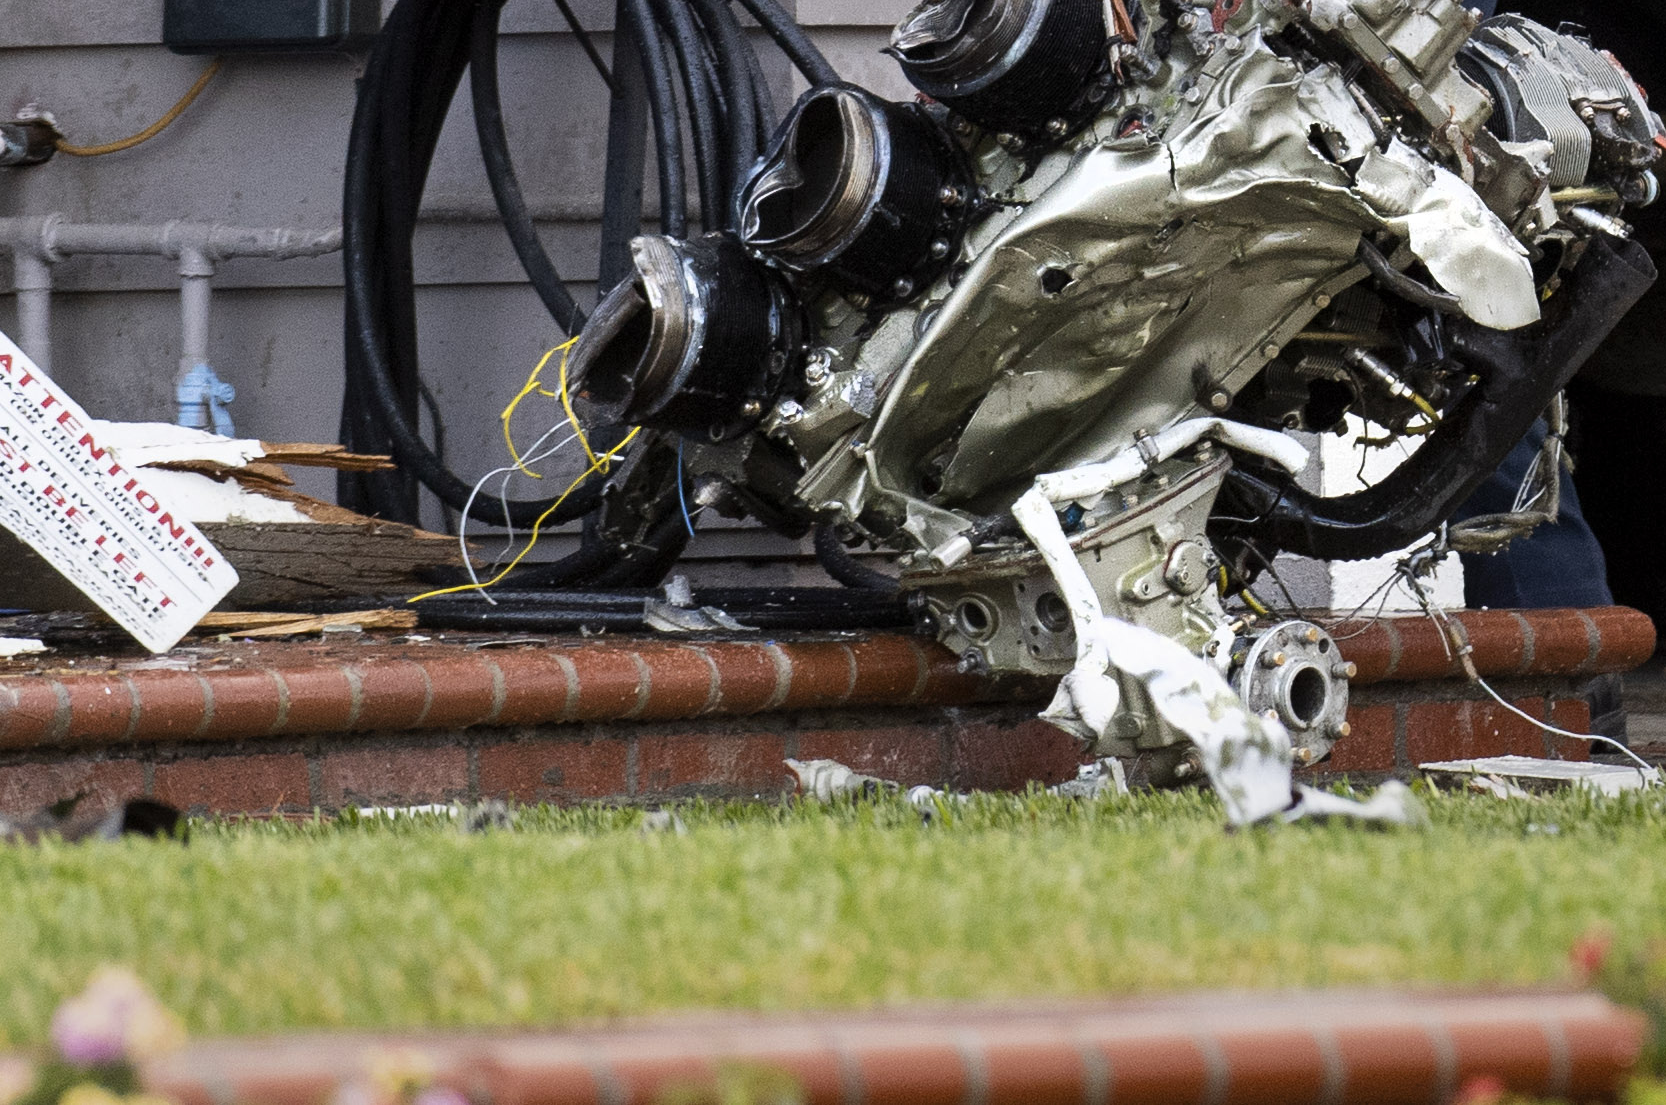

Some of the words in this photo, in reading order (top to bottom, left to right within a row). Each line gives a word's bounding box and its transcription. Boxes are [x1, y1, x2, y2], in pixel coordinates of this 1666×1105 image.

[41, 429, 90, 476] OTHER
[51, 426, 81, 455] FED
[0, 437, 33, 473] ST
[42, 485, 86, 525] BE
[94, 535, 176, 608] LEFT
[20, 481, 100, 557] DOUBLE
[113, 569, 162, 618] GATE
[37, 460, 138, 559] DELIVERIES
